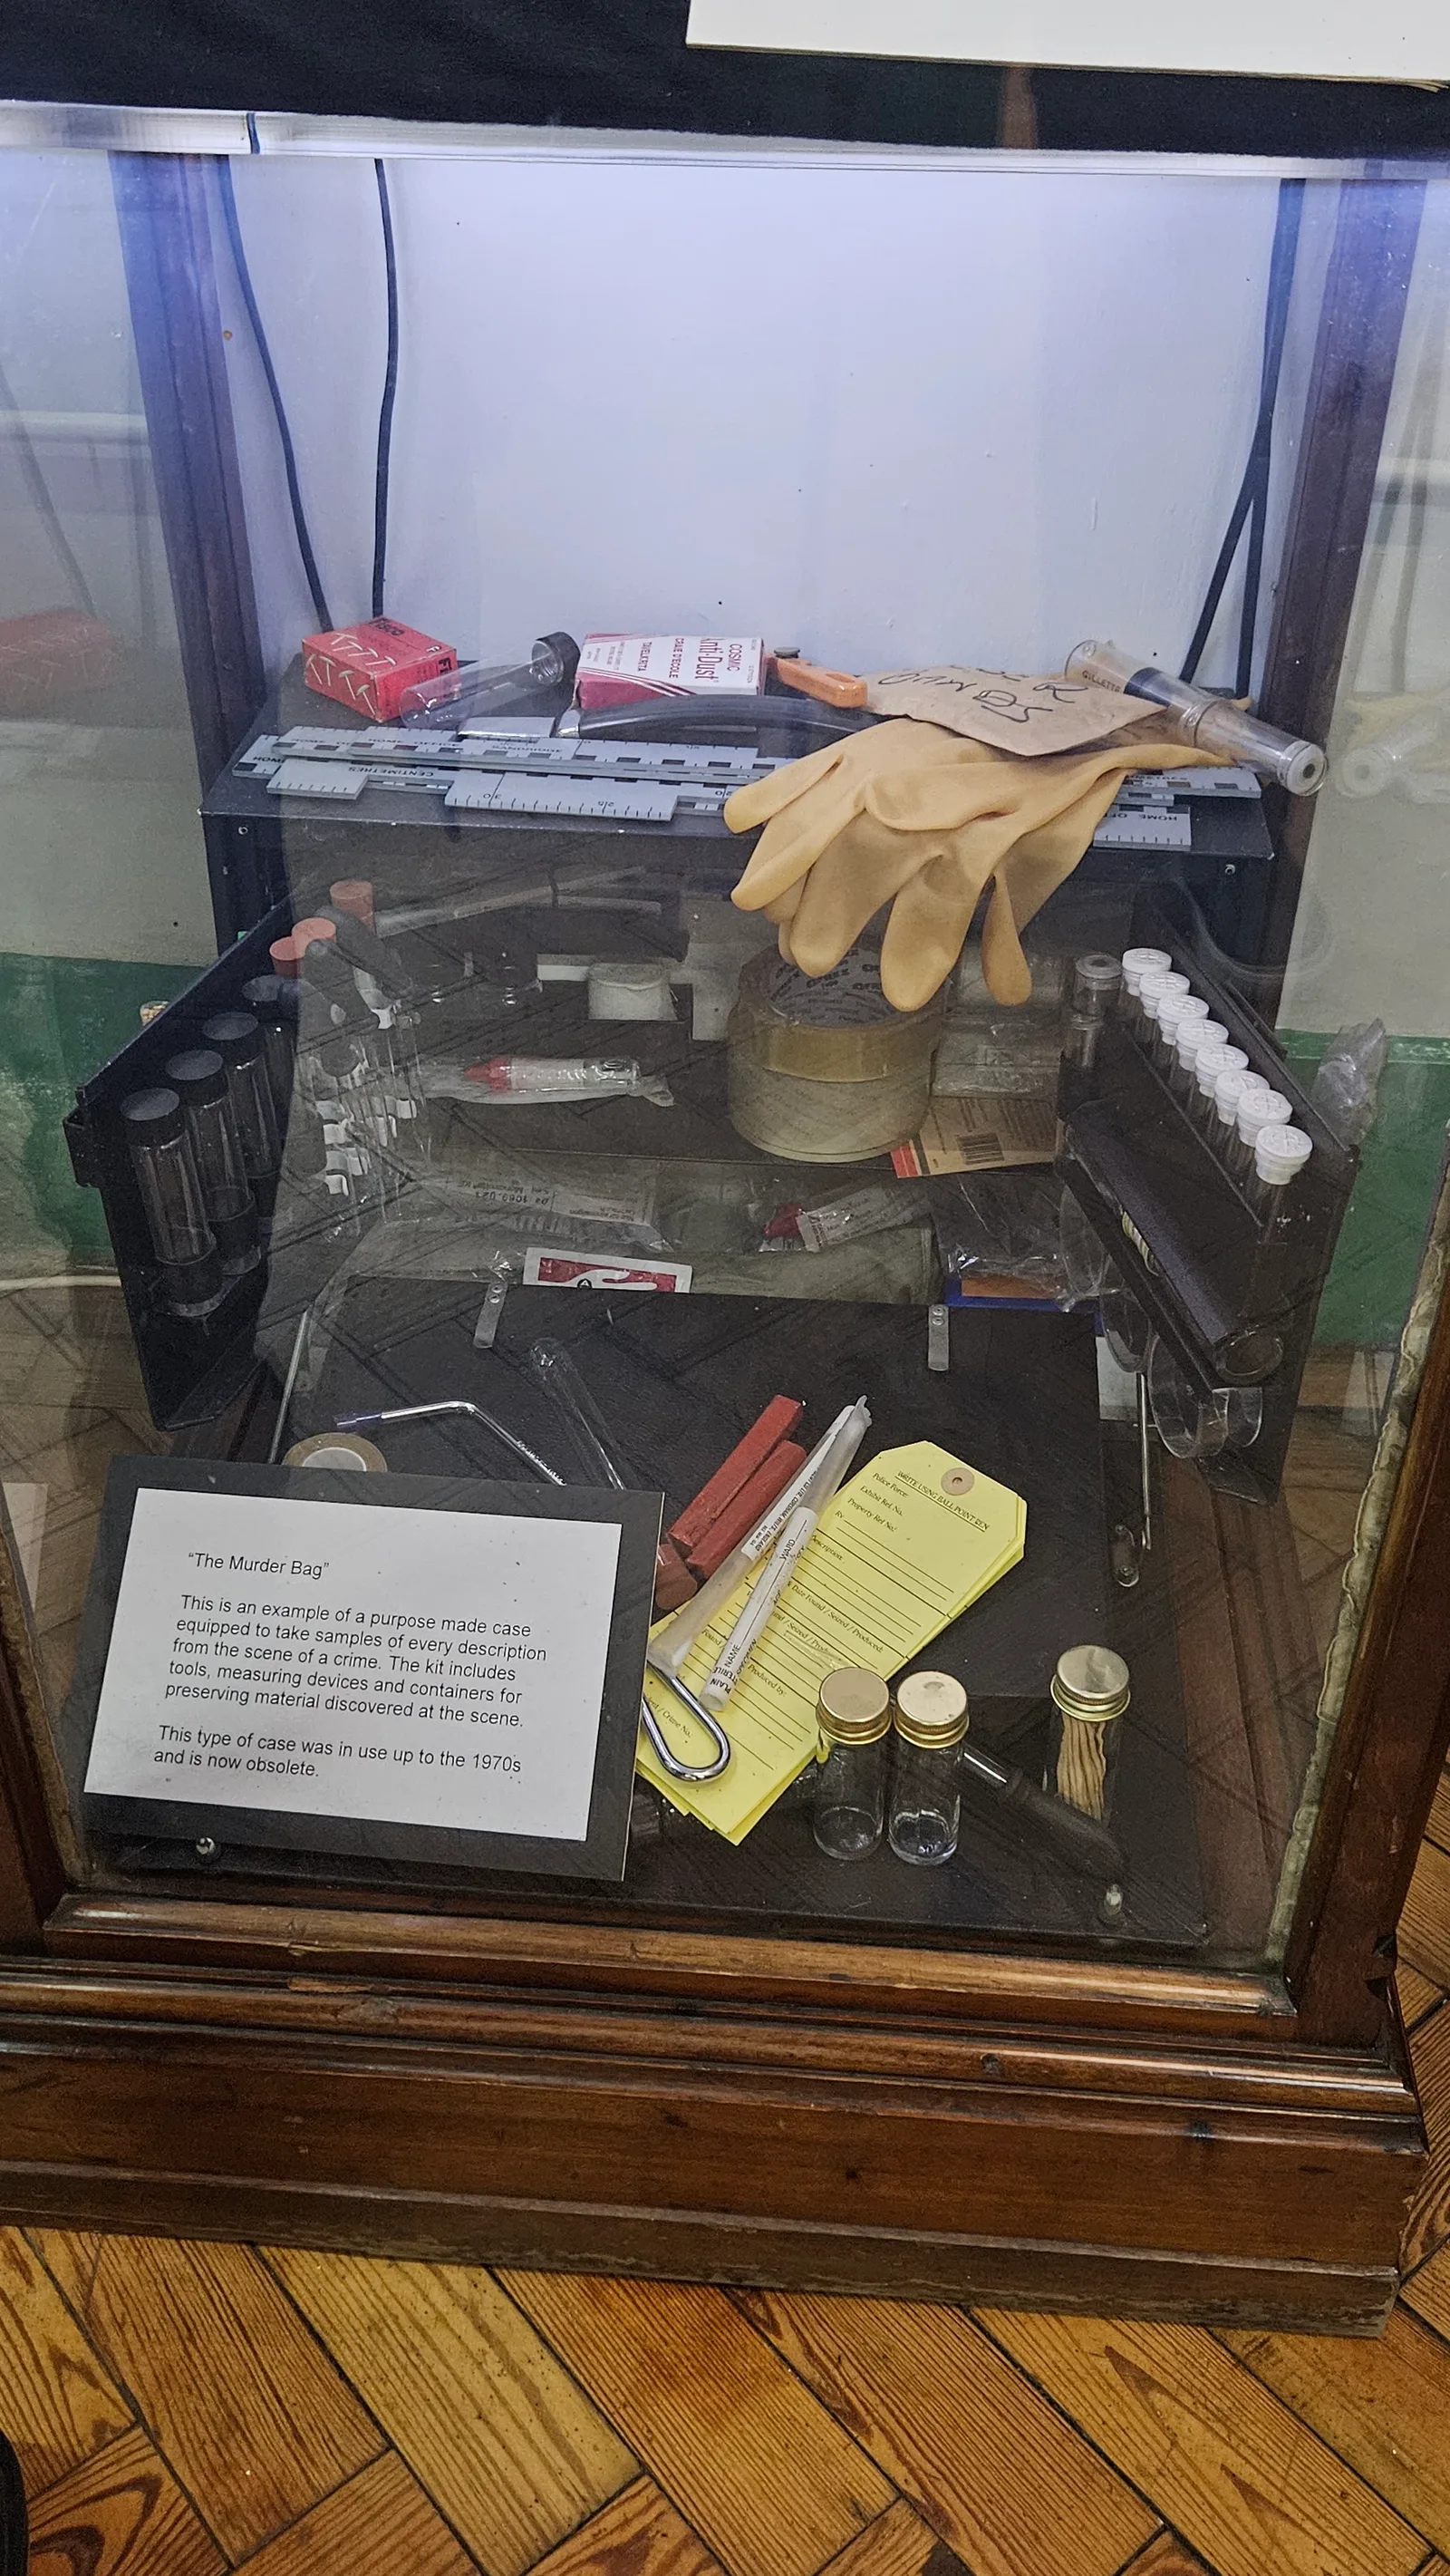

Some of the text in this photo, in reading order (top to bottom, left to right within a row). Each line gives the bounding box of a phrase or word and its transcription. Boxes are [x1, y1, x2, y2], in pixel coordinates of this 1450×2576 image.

[727, 644, 742, 672] COSMIC
[1081, 670, 1122, 693] GILLETTE
[348, 767, 434, 778] CENTIMETRES
[872, 1472, 892, 1487] Police
[860, 1486, 883, 1502] Exhibit
[897, 1470, 917, 1487] WRITE
[918, 1483, 938, 1499] USING
[936, 1495, 954, 1510] BALL
[953, 1506, 976, 1522] POINT
[847, 1497, 875, 1518] Property
[779, 1538, 797, 1560] WARD
[228, 1554, 287, 1574] Murder
[180, 1593, 531, 1637] This is an example of a purpose made case
[791, 1584, 807, 1597] Date
[806, 1593, 826, 1612] Found
[827, 1611, 850, 1629] Seized
[176, 1618, 546, 1662] equipped to take samples of every description
[788, 1622, 809, 1641] Seized
[172, 1637, 516, 1681] from the scene of a crime. The kit includes
[702, 1629, 722, 1646] Found
[748, 1663, 777, 1689] Produced
[724, 1643, 741, 1668] NAME
[169, 1660, 523, 1704] tools, measuring devices and containers for
[710, 1678, 732, 1695] PLAIN
[164, 1684, 523, 1728] preserving material discovered at the scene.
[662, 1710, 682, 1729] Crime
[159, 1724, 521, 1773] This type of case was in use up to the 1970s
[153, 1749, 319, 1777] and is now obsolete.
